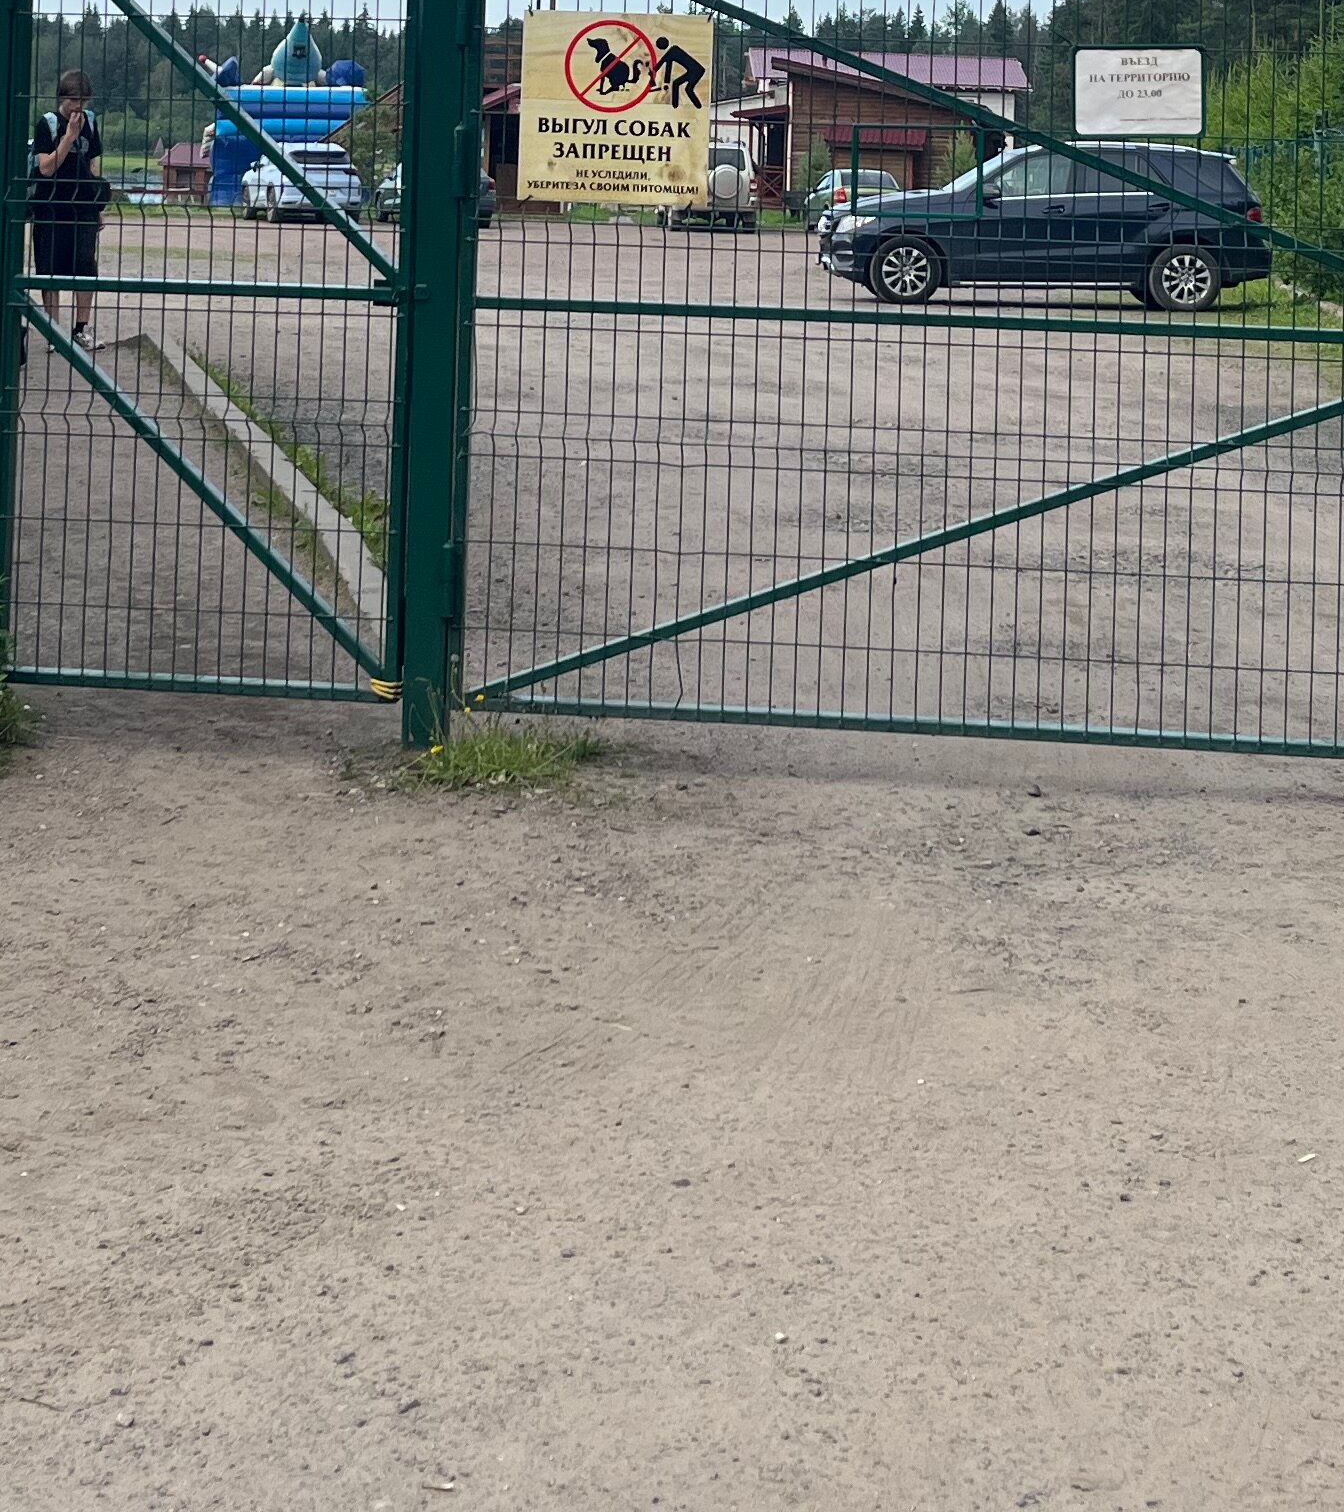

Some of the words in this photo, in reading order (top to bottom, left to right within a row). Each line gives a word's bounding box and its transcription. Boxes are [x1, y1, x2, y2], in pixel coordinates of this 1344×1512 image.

[1120, 56, 1159, 67] ВЪЕЗД
[1089, 73, 1106, 83] НА
[1108, 72, 1191, 83] ТЕРРИТОРИЮ
[1117, 89, 1134, 99] ДО
[537, 117, 608, 136] ВЫГУЛ
[614, 119, 691, 138] СОБАК
[552, 141, 672, 164] ЗАПРЕЩЕН
[576, 169, 589, 178] НЕ
[527, 180, 571, 189] УБЕРИТЕ
[573, 181, 586, 190] ЗА
[589, 182, 630, 192] СВОИМ
[632, 183, 699, 195] ПИТОМЦЕМ!
